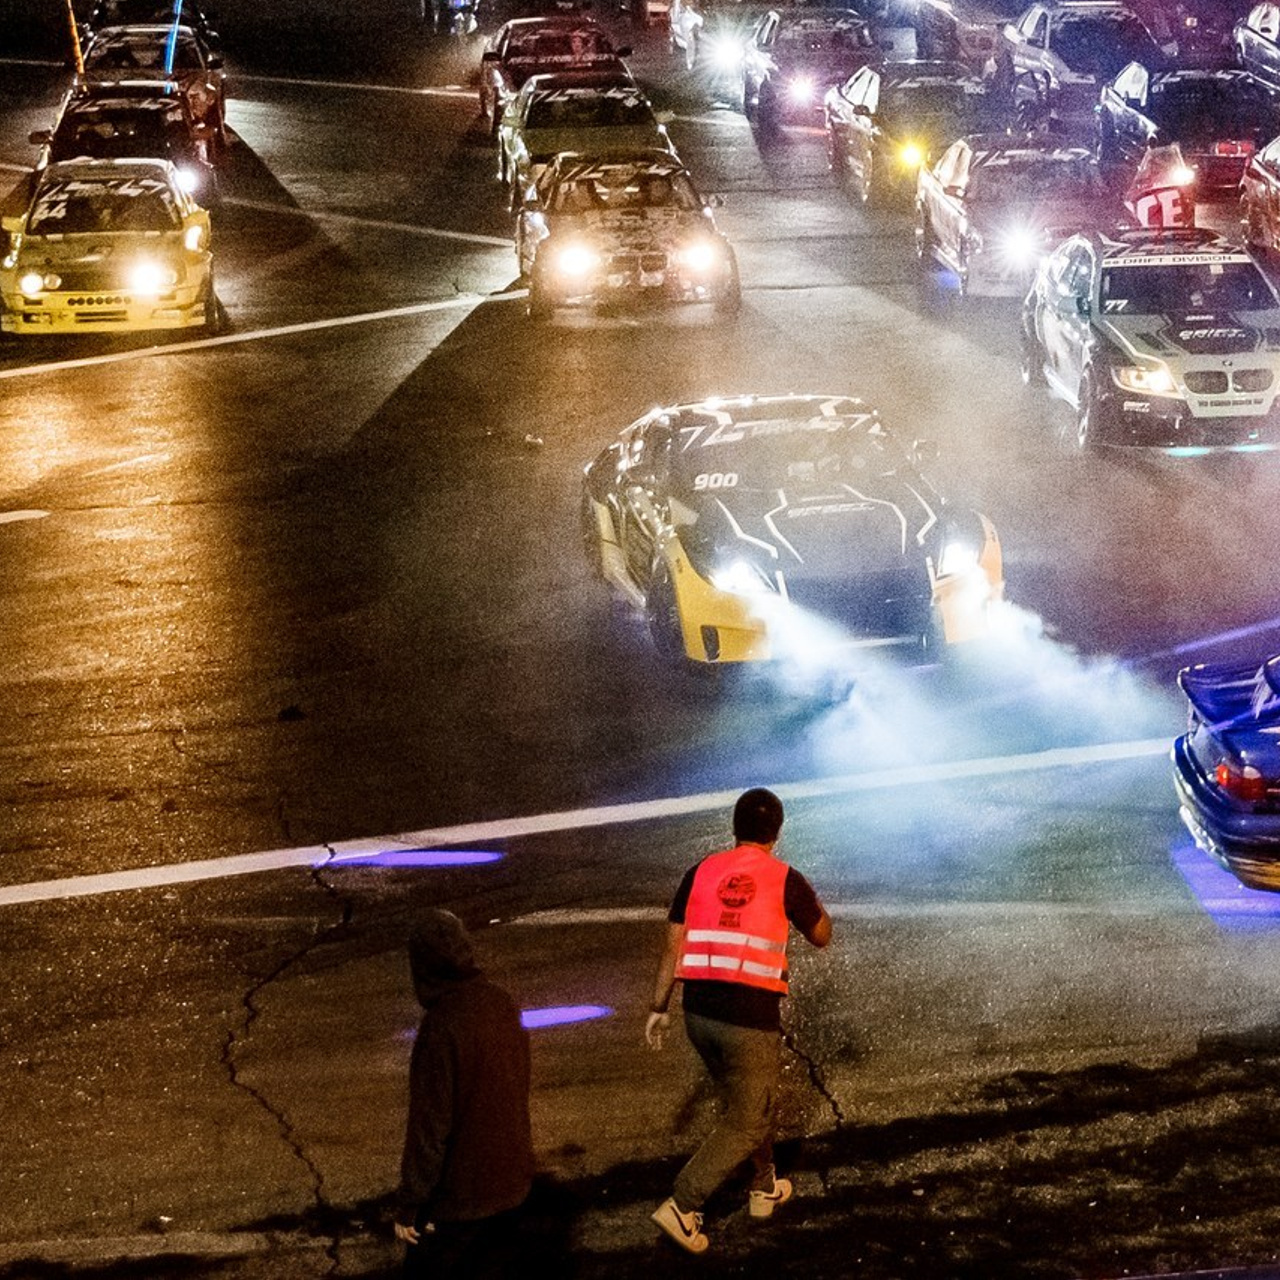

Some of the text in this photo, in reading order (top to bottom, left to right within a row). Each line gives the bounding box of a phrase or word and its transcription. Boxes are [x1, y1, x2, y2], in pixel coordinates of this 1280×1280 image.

[1122, 255, 1233, 265] DRIFT DIVISION
[1104, 299, 1128, 311] 77
[694, 472, 739, 491] 900
